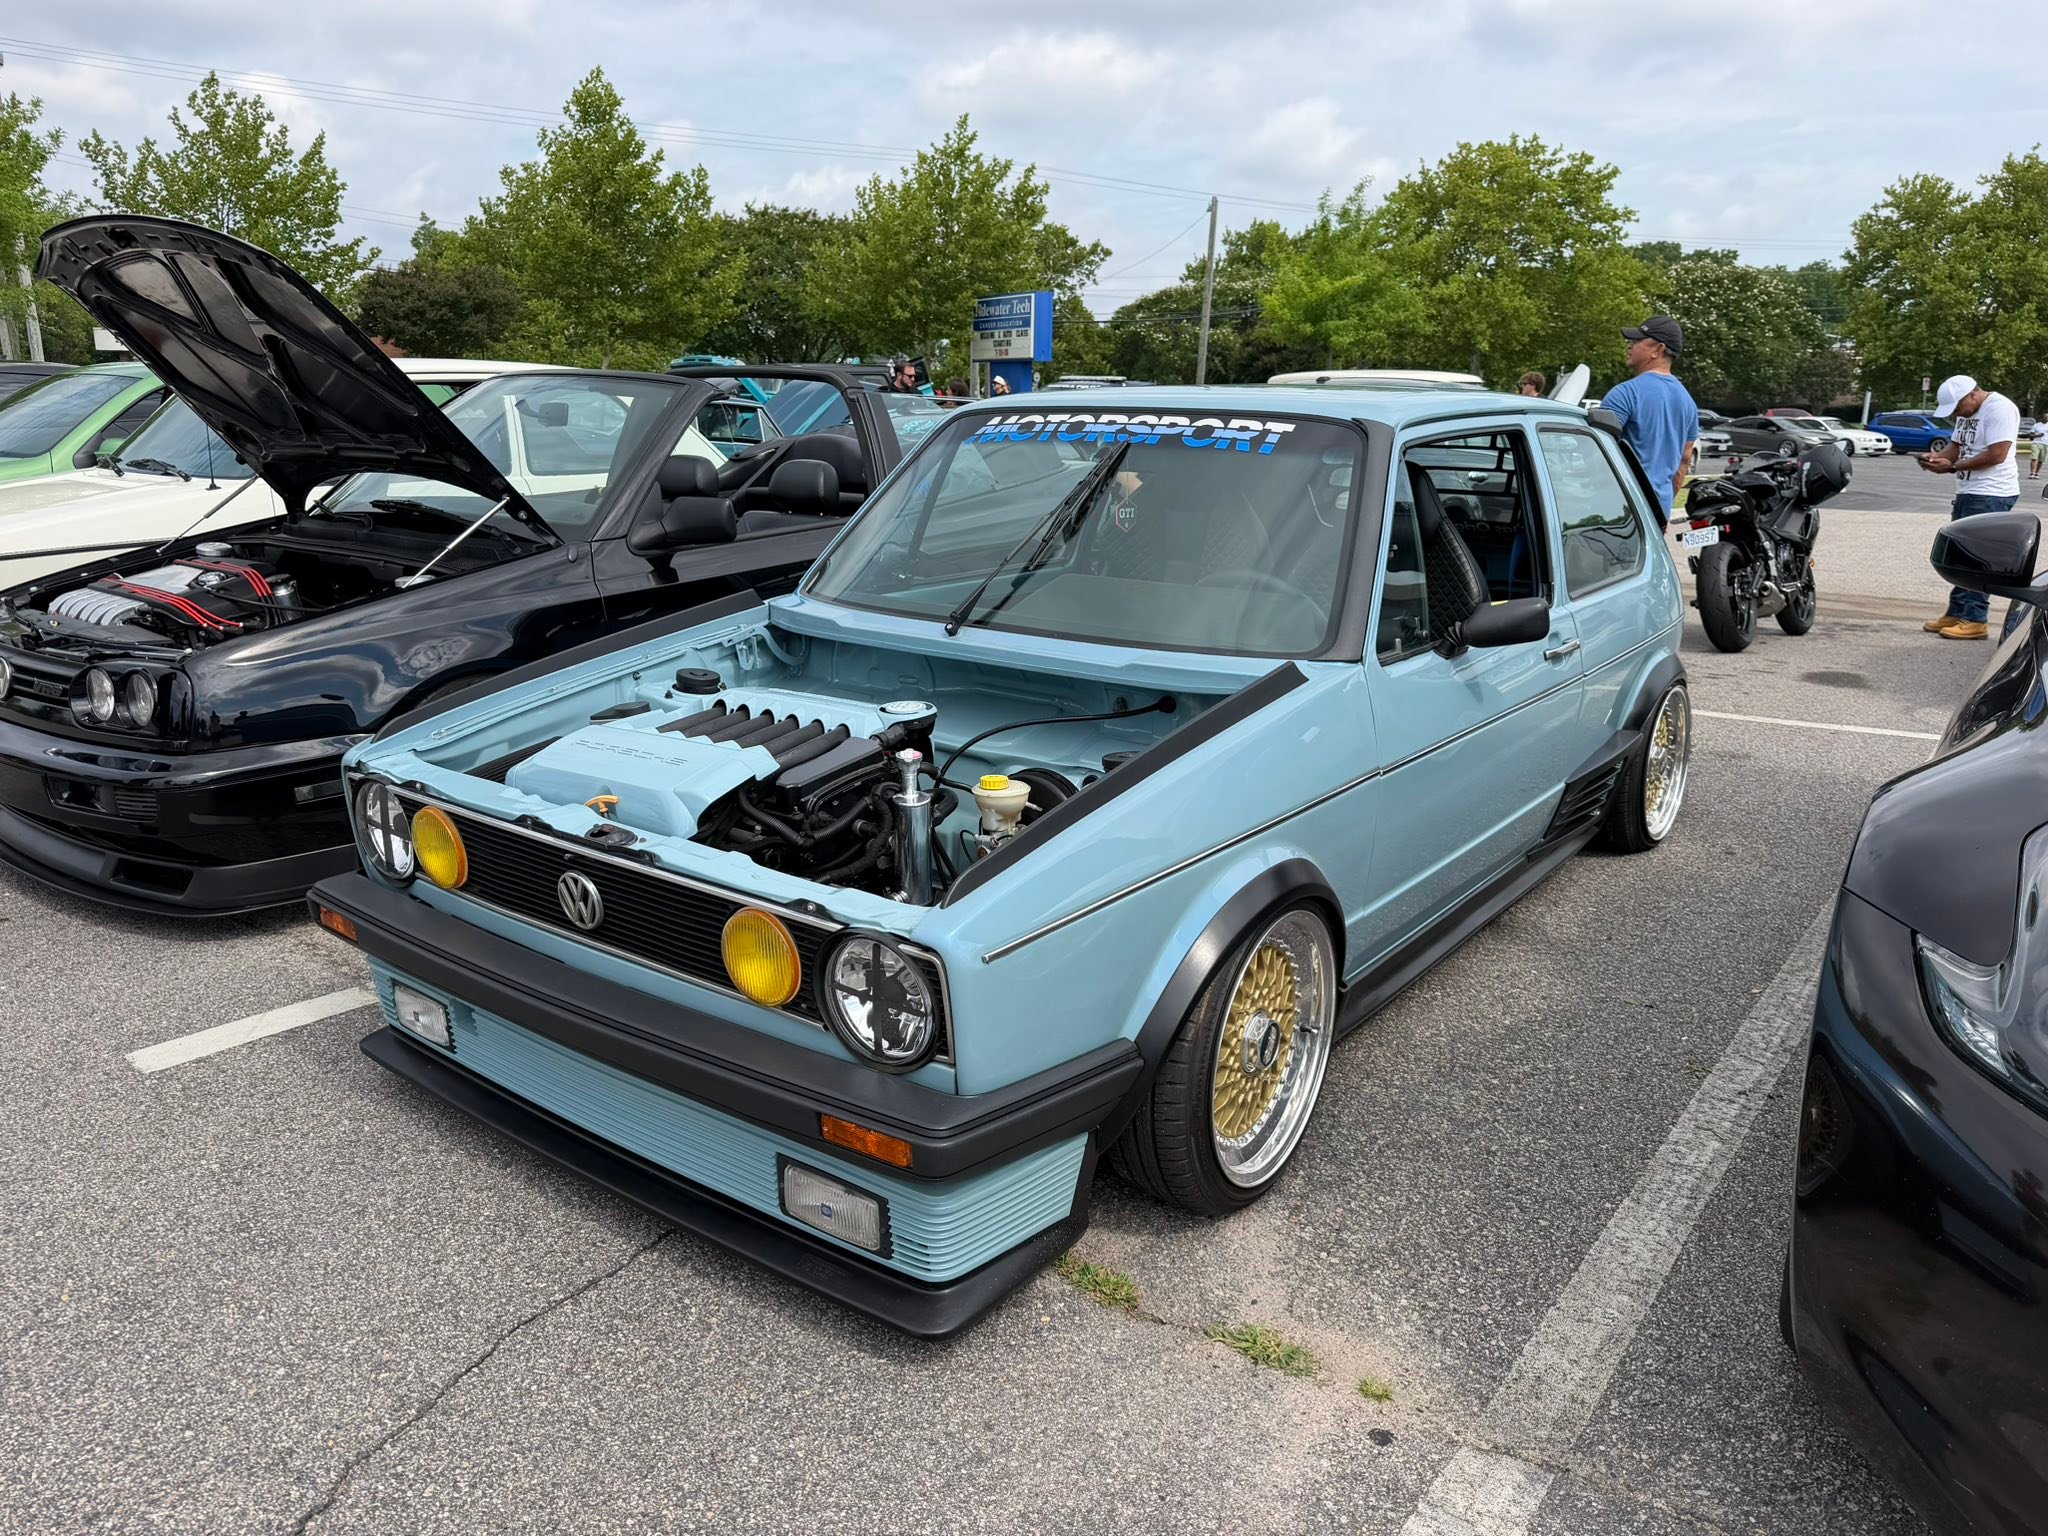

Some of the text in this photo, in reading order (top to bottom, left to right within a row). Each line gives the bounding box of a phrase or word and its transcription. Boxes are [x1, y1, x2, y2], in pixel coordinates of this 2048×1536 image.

[1012, 299, 1030, 314] Tech
[964, 414, 1296, 455] MOTORSPORT
[1119, 508, 1135, 519] GTI
[571, 739, 688, 766] PORSCHE
